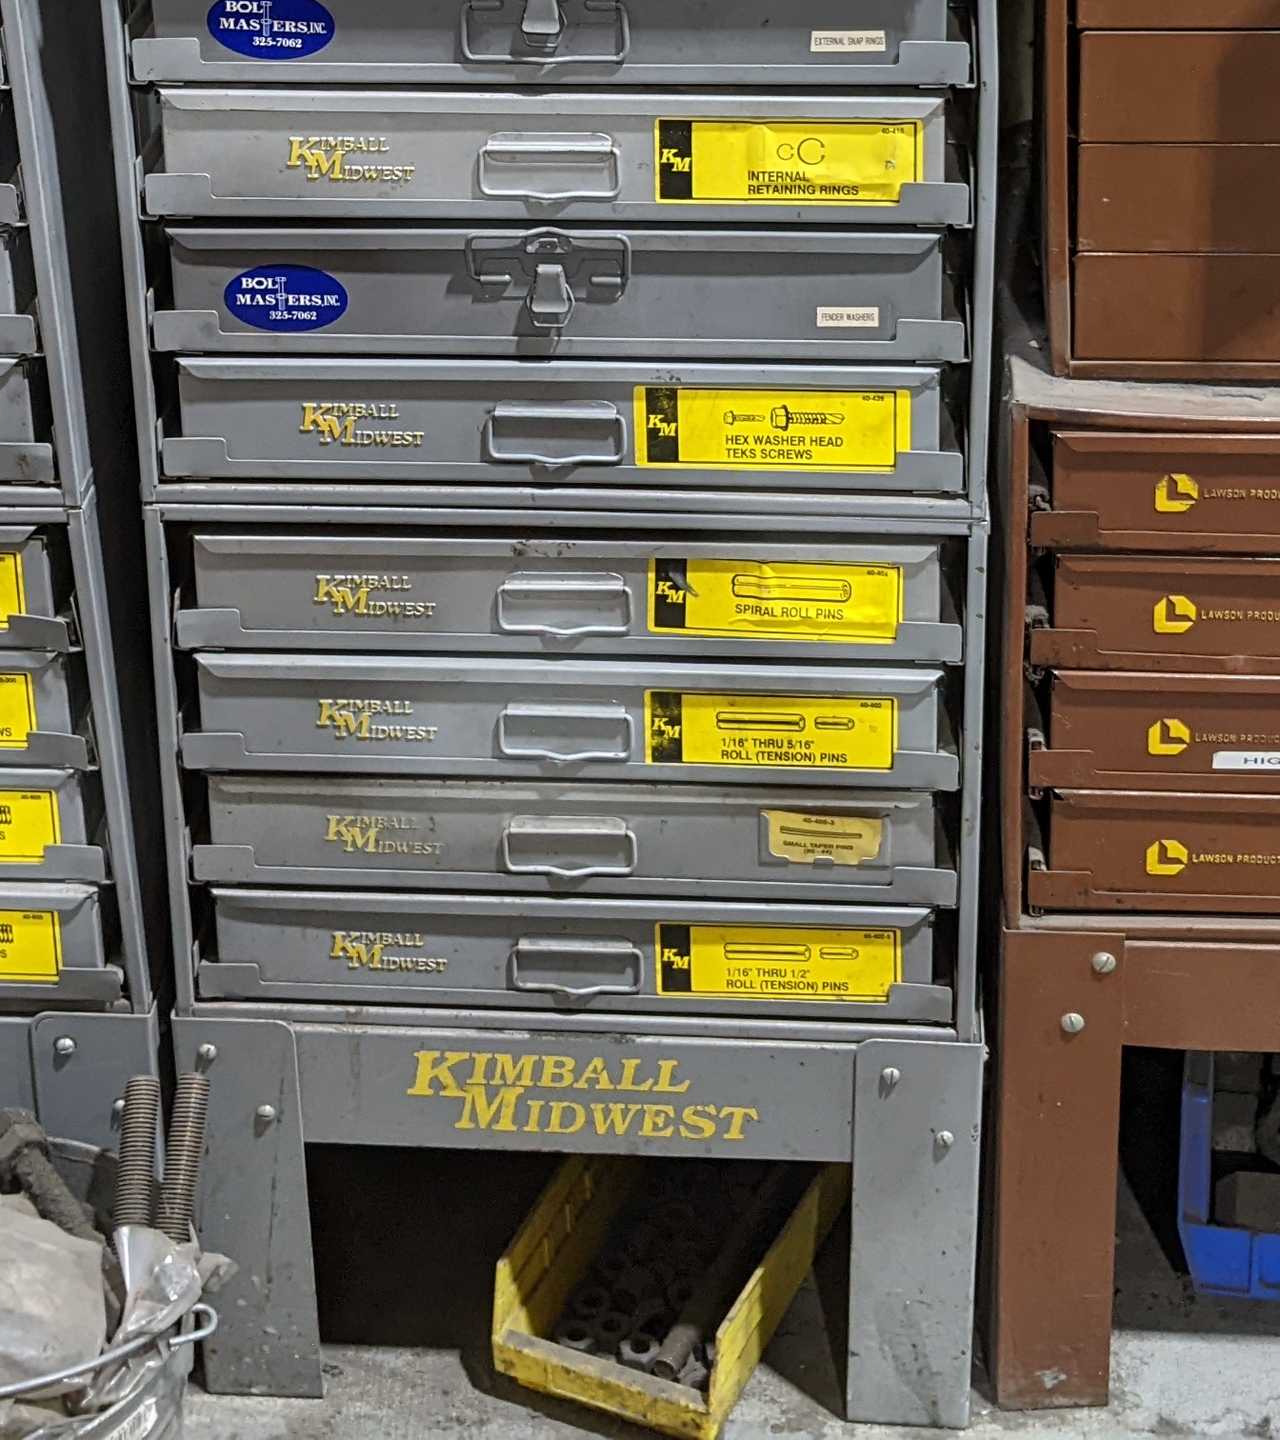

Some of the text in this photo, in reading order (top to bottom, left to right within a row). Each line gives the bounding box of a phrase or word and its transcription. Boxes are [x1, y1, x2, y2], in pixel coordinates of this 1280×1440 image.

[252, 36, 303, 48] 325-7062
[814, 37, 885, 46] EXTERNAL SNAP RINGS
[286, 137, 390, 169] KIMBALL
[307, 151, 415, 182] MIDWEST
[747, 170, 809, 182] INTERNAL
[747, 183, 859, 196] RETAINING RINGS
[269, 310, 317, 320] 325-7062
[821, 313, 875, 322] FENDER WASHERS
[725, 435, 844, 448] HEX WASHER HEAD
[725, 448, 813, 460] TEKS SCREWS
[314, 575, 412, 602] KIMBALL
[334, 588, 437, 616] MIDWEST
[735, 603, 844, 620] SPIRAL ROLL PINS
[1201, 610, 1243, 620] LAWSON
[751, 739, 784, 750] THRU
[721, 749, 848, 763] ROLL (TENSION) PINS
[756, 968, 788, 979] THRU
[726, 979, 849, 993] ROLL (TENSION) PINS
[406, 1051, 691, 1099] KIMBALL
[454, 1085, 758, 1141] MIDWEST
